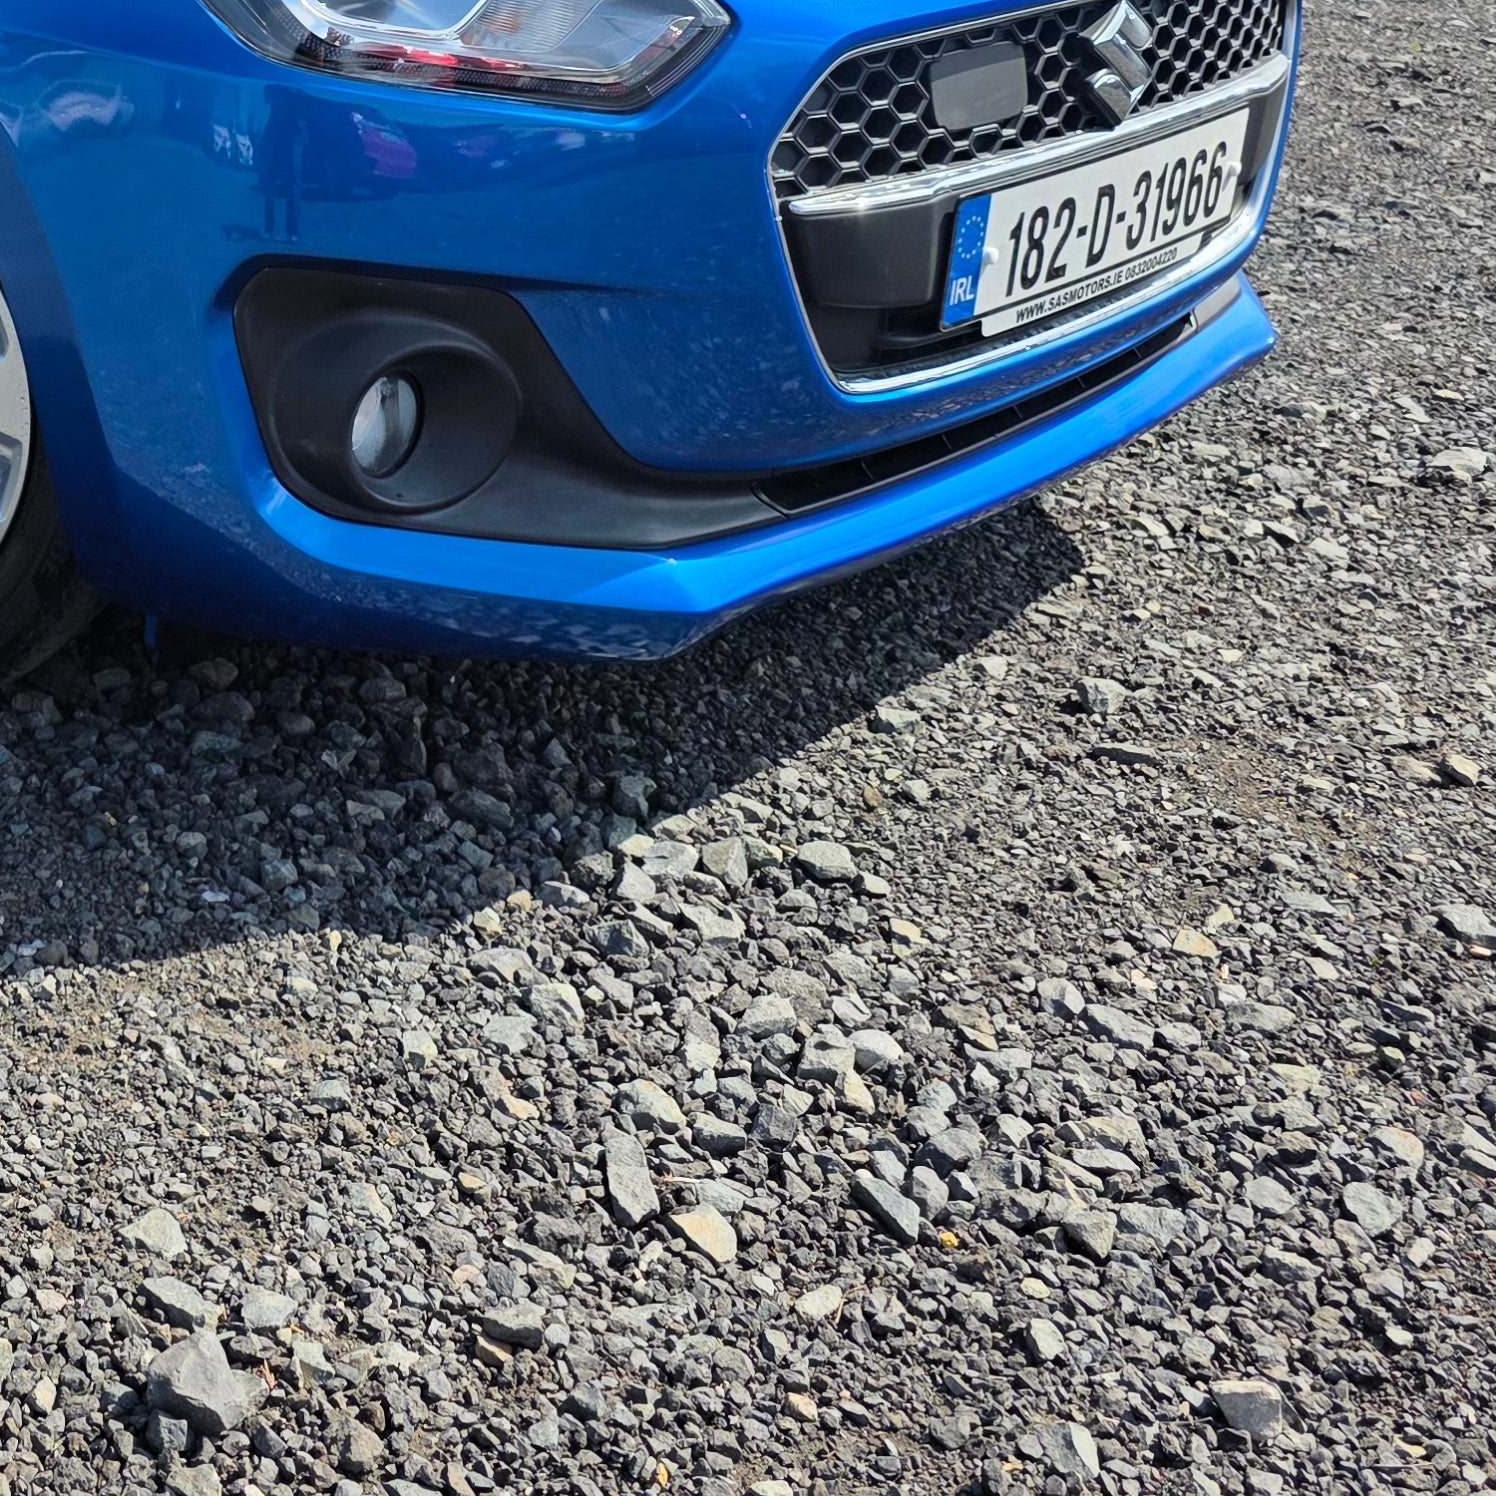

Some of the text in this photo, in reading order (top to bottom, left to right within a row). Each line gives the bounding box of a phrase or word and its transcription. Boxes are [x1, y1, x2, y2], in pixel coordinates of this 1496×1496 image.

[1005, 141, 1228, 298] 182-D-31966
[949, 275, 974, 306] IRL
[1015, 247, 1178, 324] WWW.SASMOTORS.IE 0832004220
